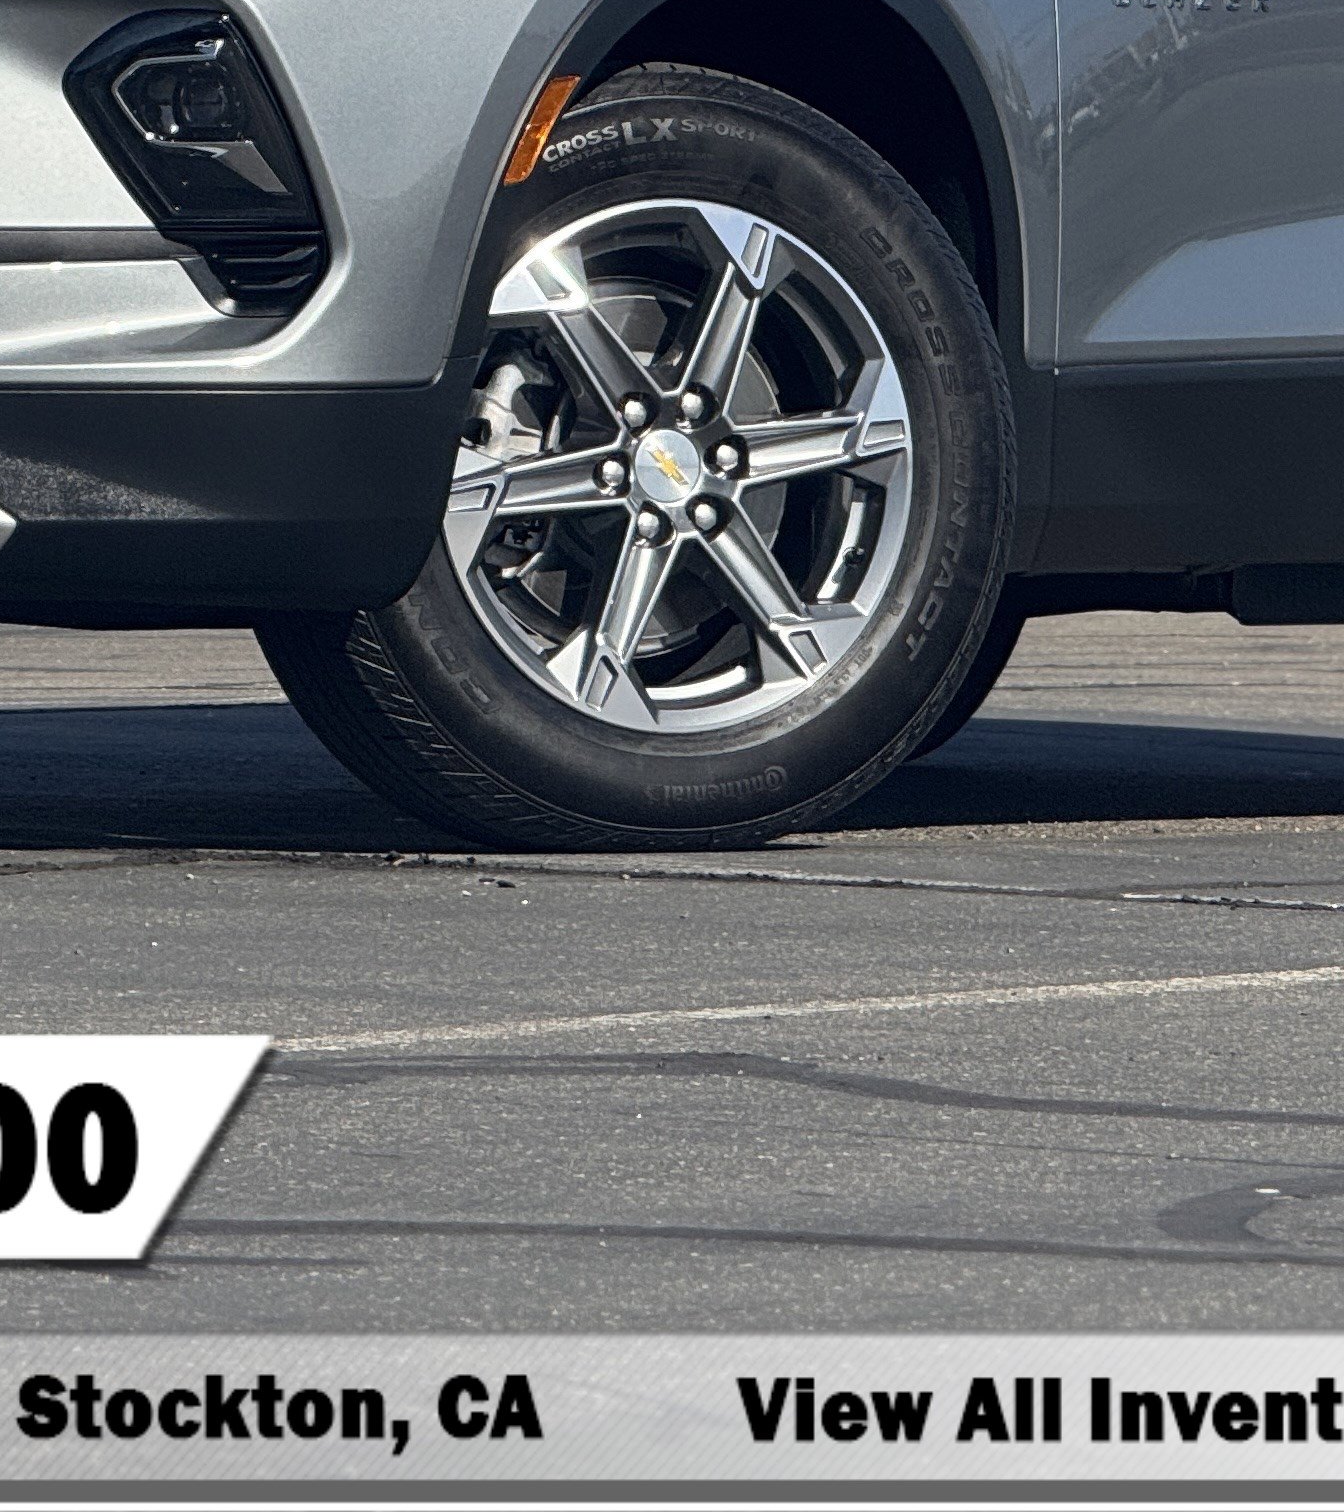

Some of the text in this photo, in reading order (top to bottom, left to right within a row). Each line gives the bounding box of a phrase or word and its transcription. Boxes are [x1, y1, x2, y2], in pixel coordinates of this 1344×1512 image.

[541, 124, 619, 163] CROSS
[621, 117, 679, 146] LX
[680, 118, 756, 143] SPORT
